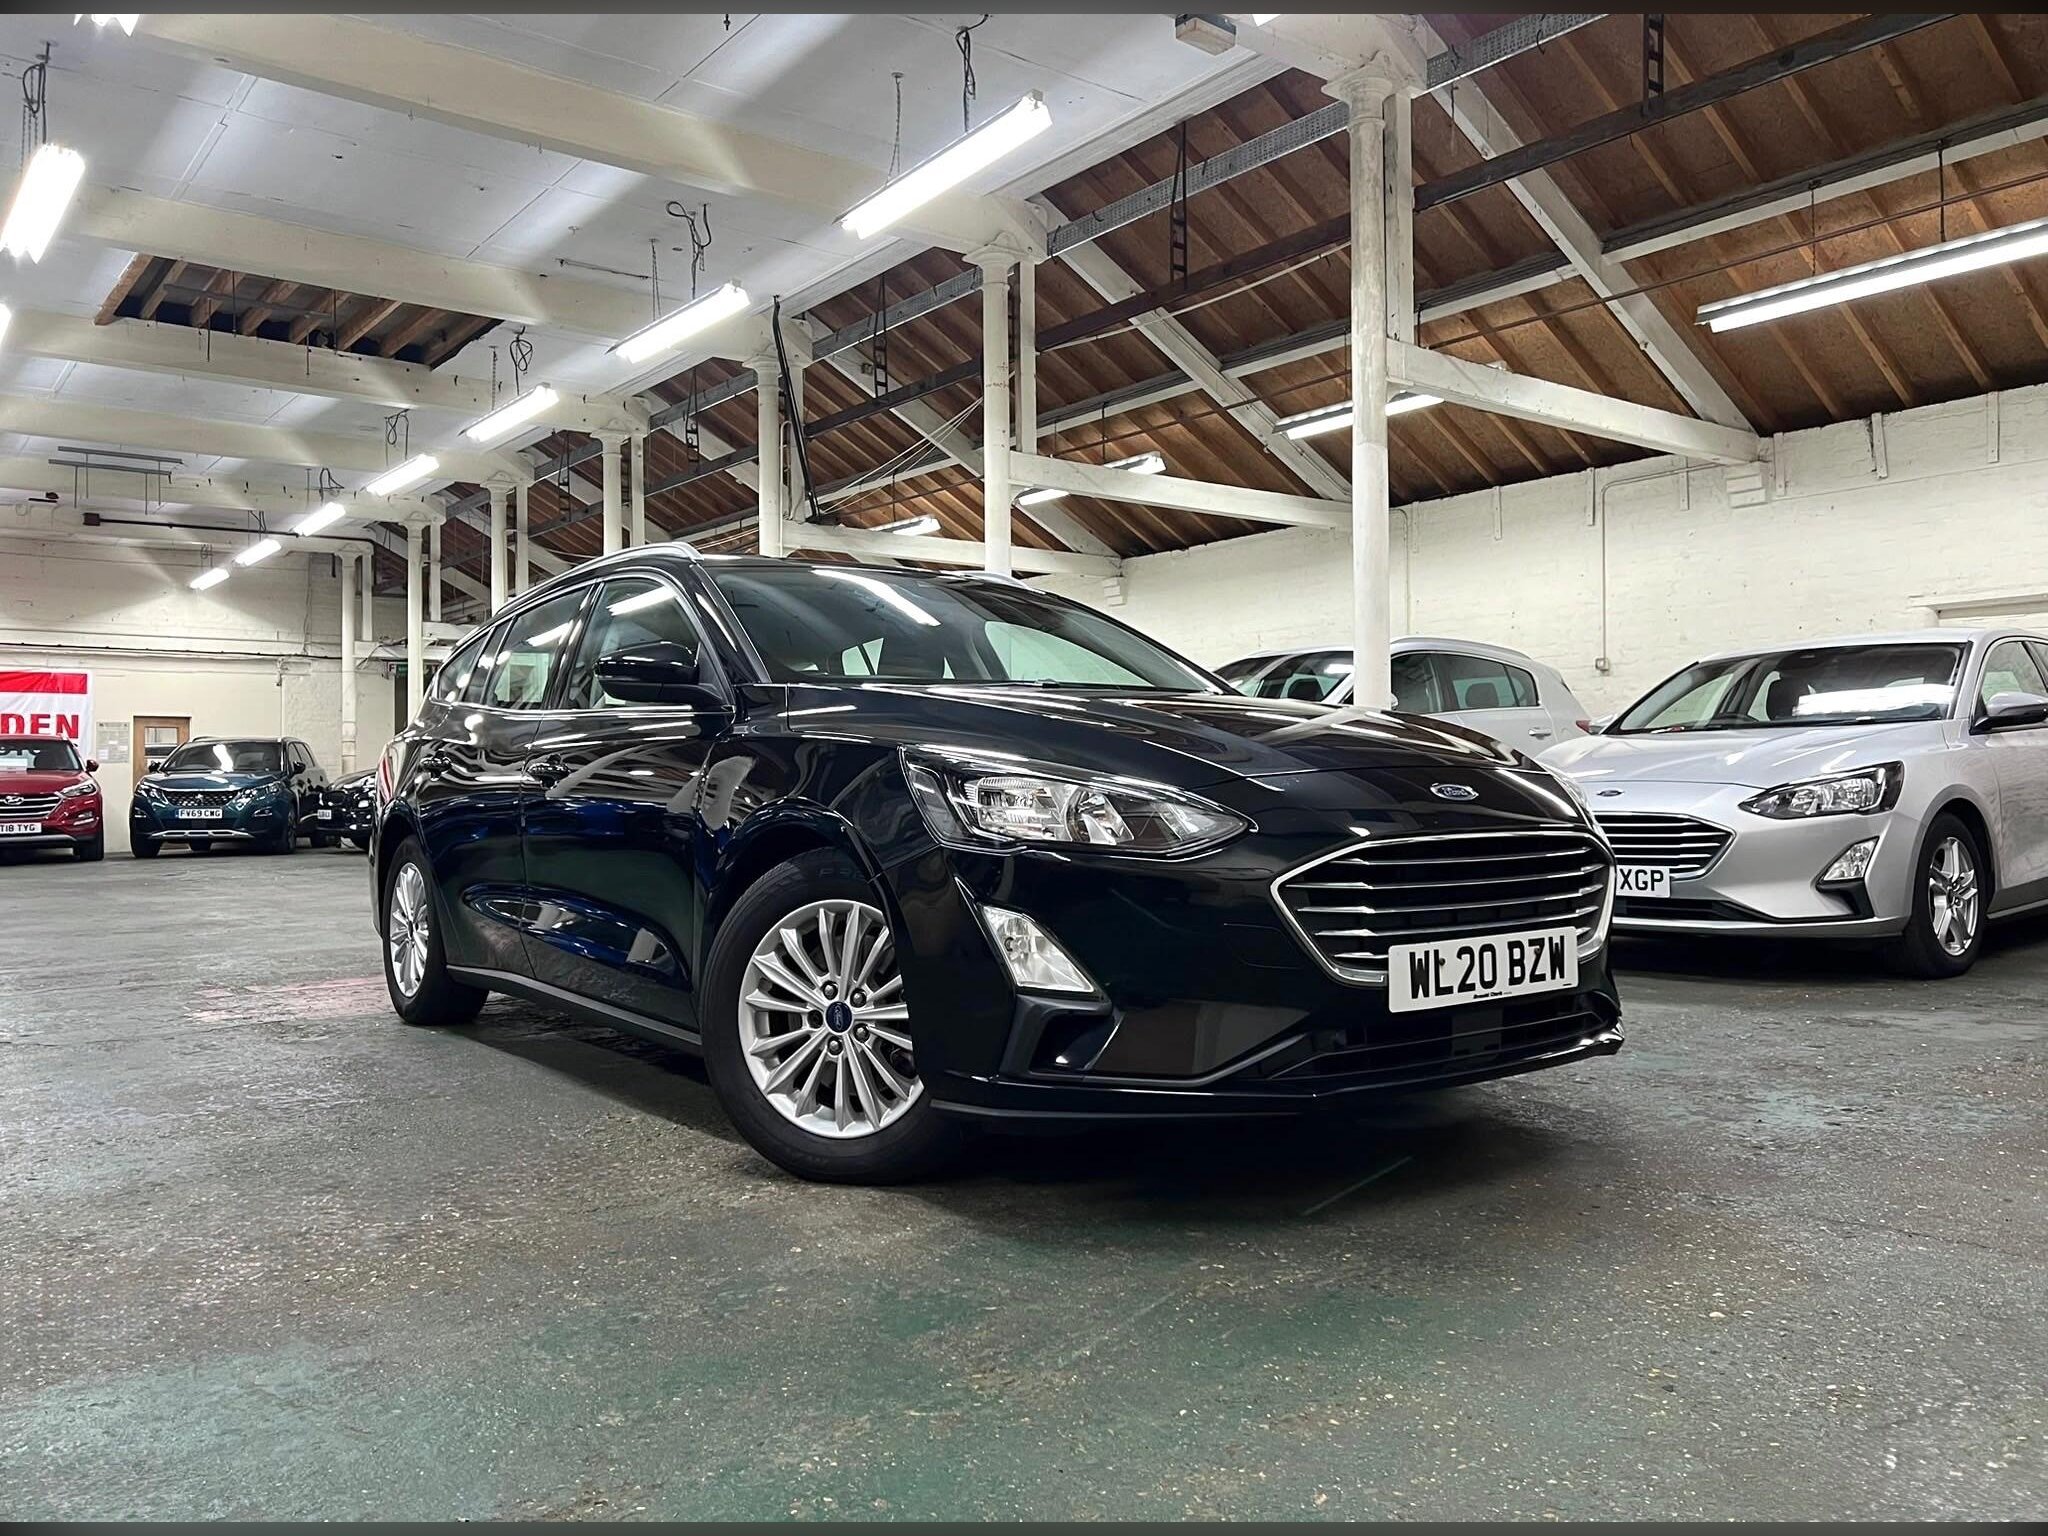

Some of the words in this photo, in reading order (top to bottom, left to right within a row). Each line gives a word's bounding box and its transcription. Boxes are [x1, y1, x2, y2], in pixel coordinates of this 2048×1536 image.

[0, 713, 79, 739] DEN
[18, 824, 36, 832] TYG
[1619, 868, 1664, 891] XGP
[1409, 943, 1497, 999] WL20
[1507, 935, 1565, 986] BZW
